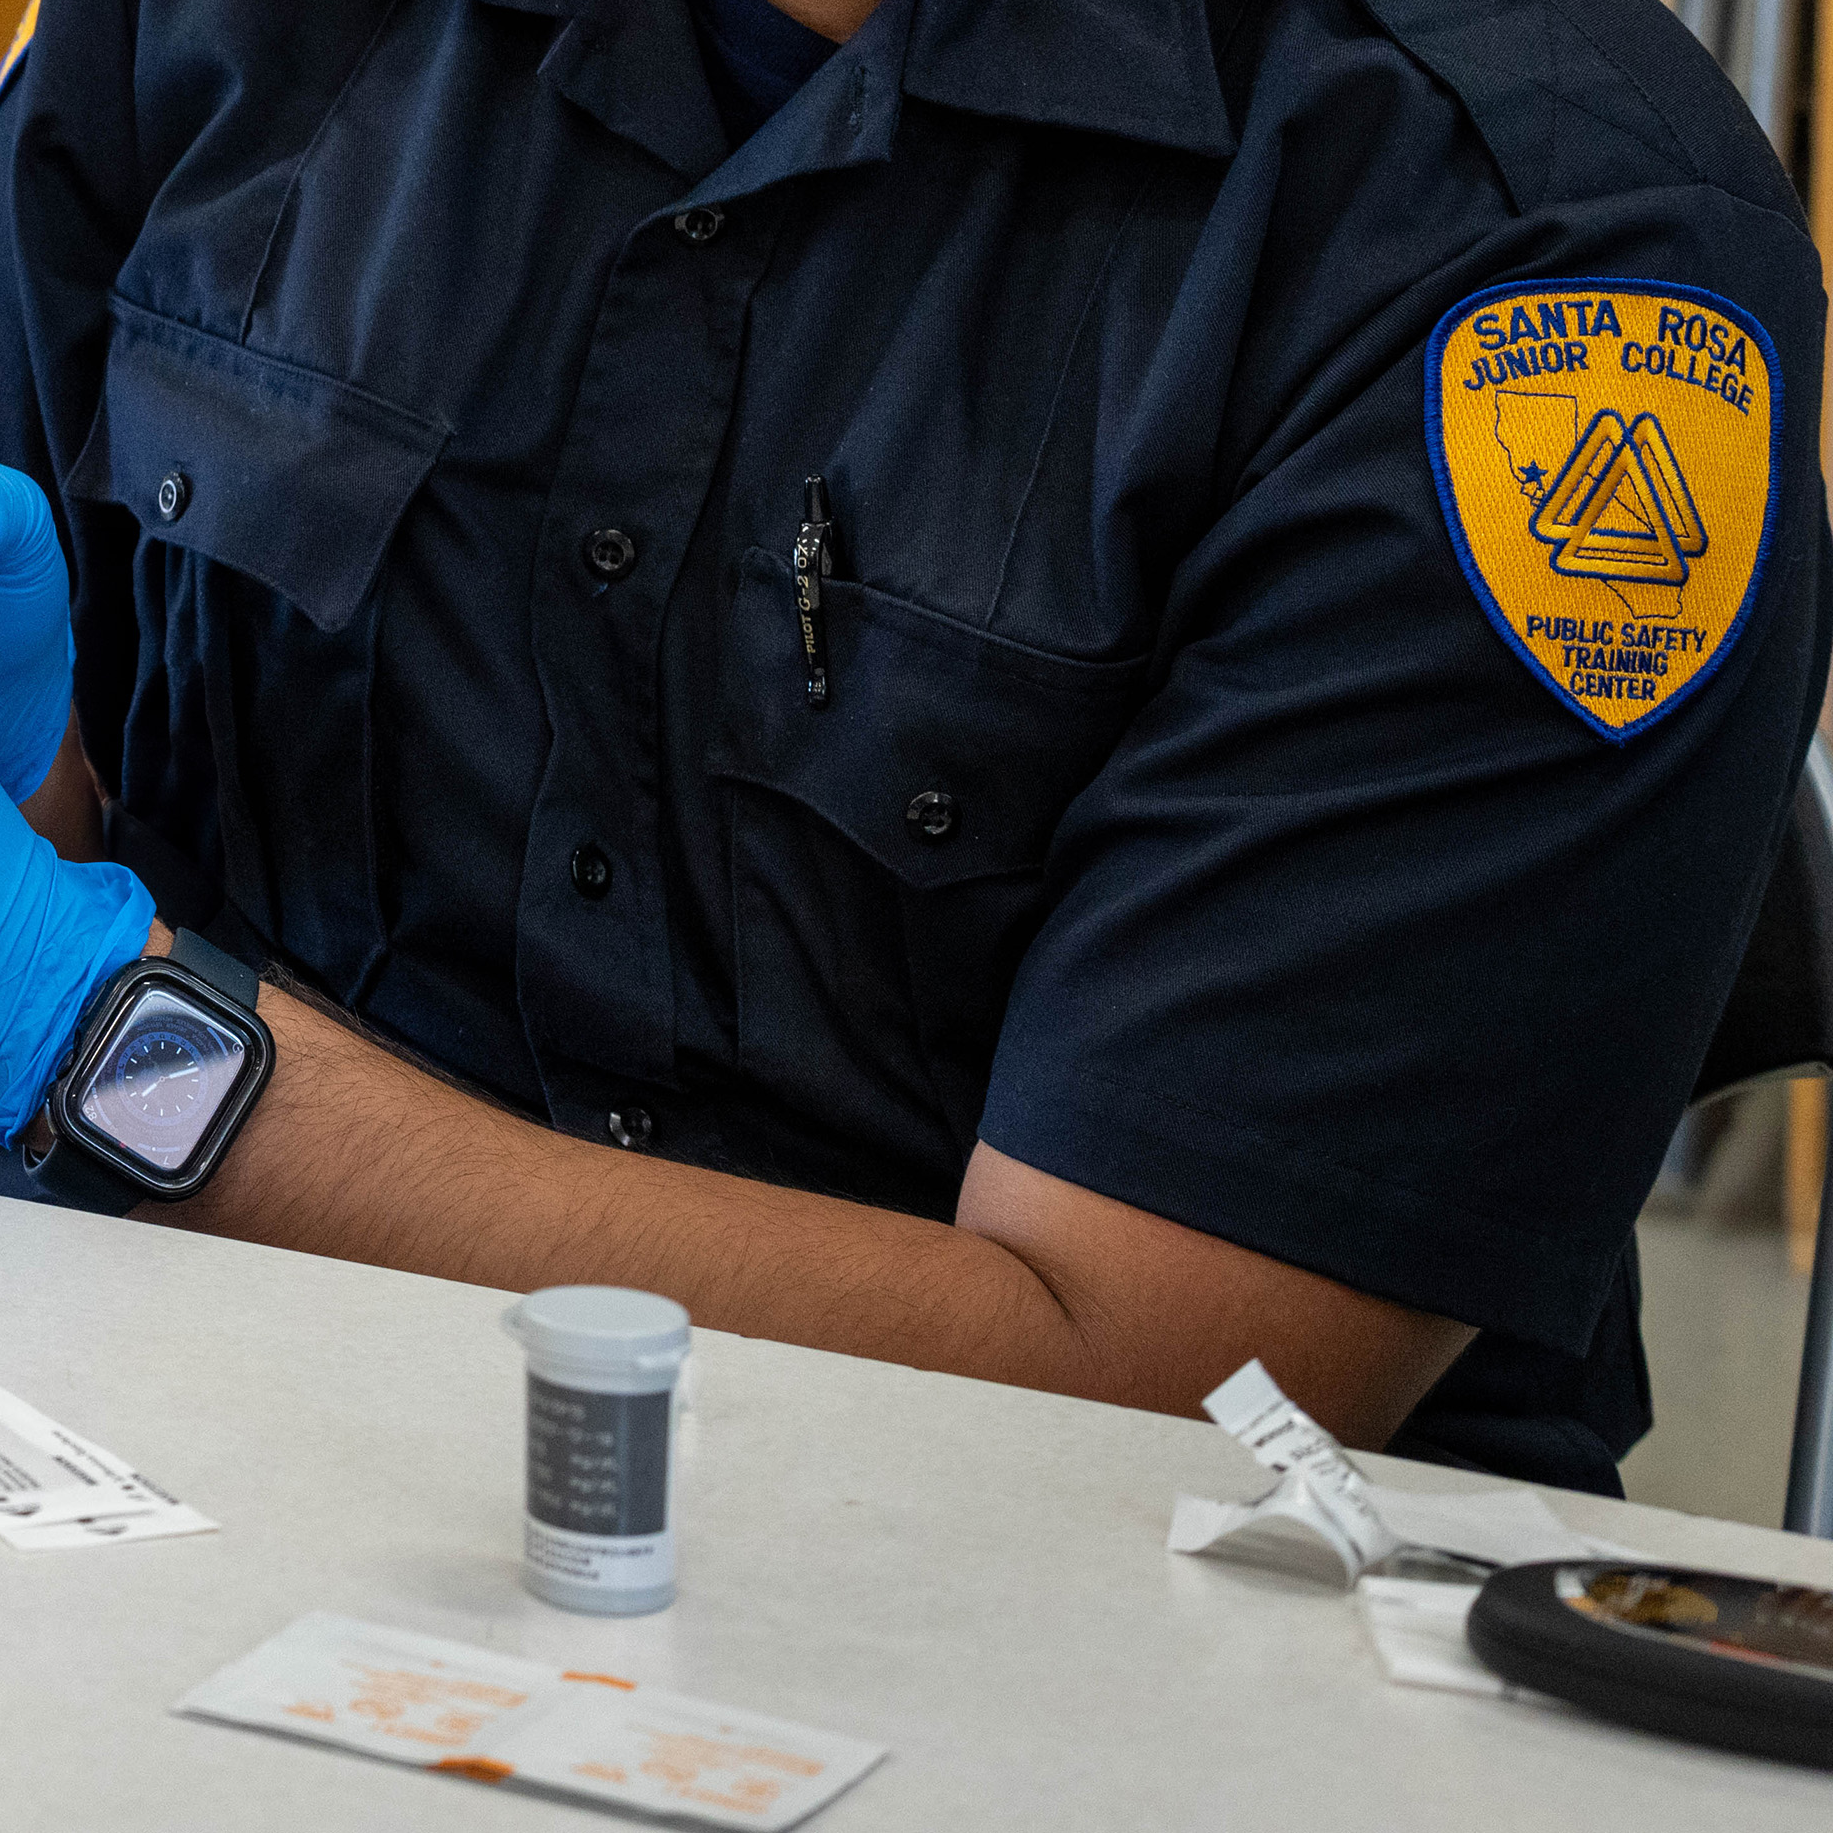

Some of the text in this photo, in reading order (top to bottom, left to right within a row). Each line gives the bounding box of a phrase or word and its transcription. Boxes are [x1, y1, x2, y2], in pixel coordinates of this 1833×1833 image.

[1472, 300, 1748, 377] SANTA ROSA
[1463, 340, 1755, 416] JUNIOR COLLEGE
[797, 575, 811, 612] G-2
[802, 614, 816, 654] PILOT
[1526, 615, 1709, 652] PUBLIC SAFETY
[1562, 645, 1669, 677] TRAINING
[1569, 671, 1657, 702] CENTER
[84, 1104, 98, 1121] 82
